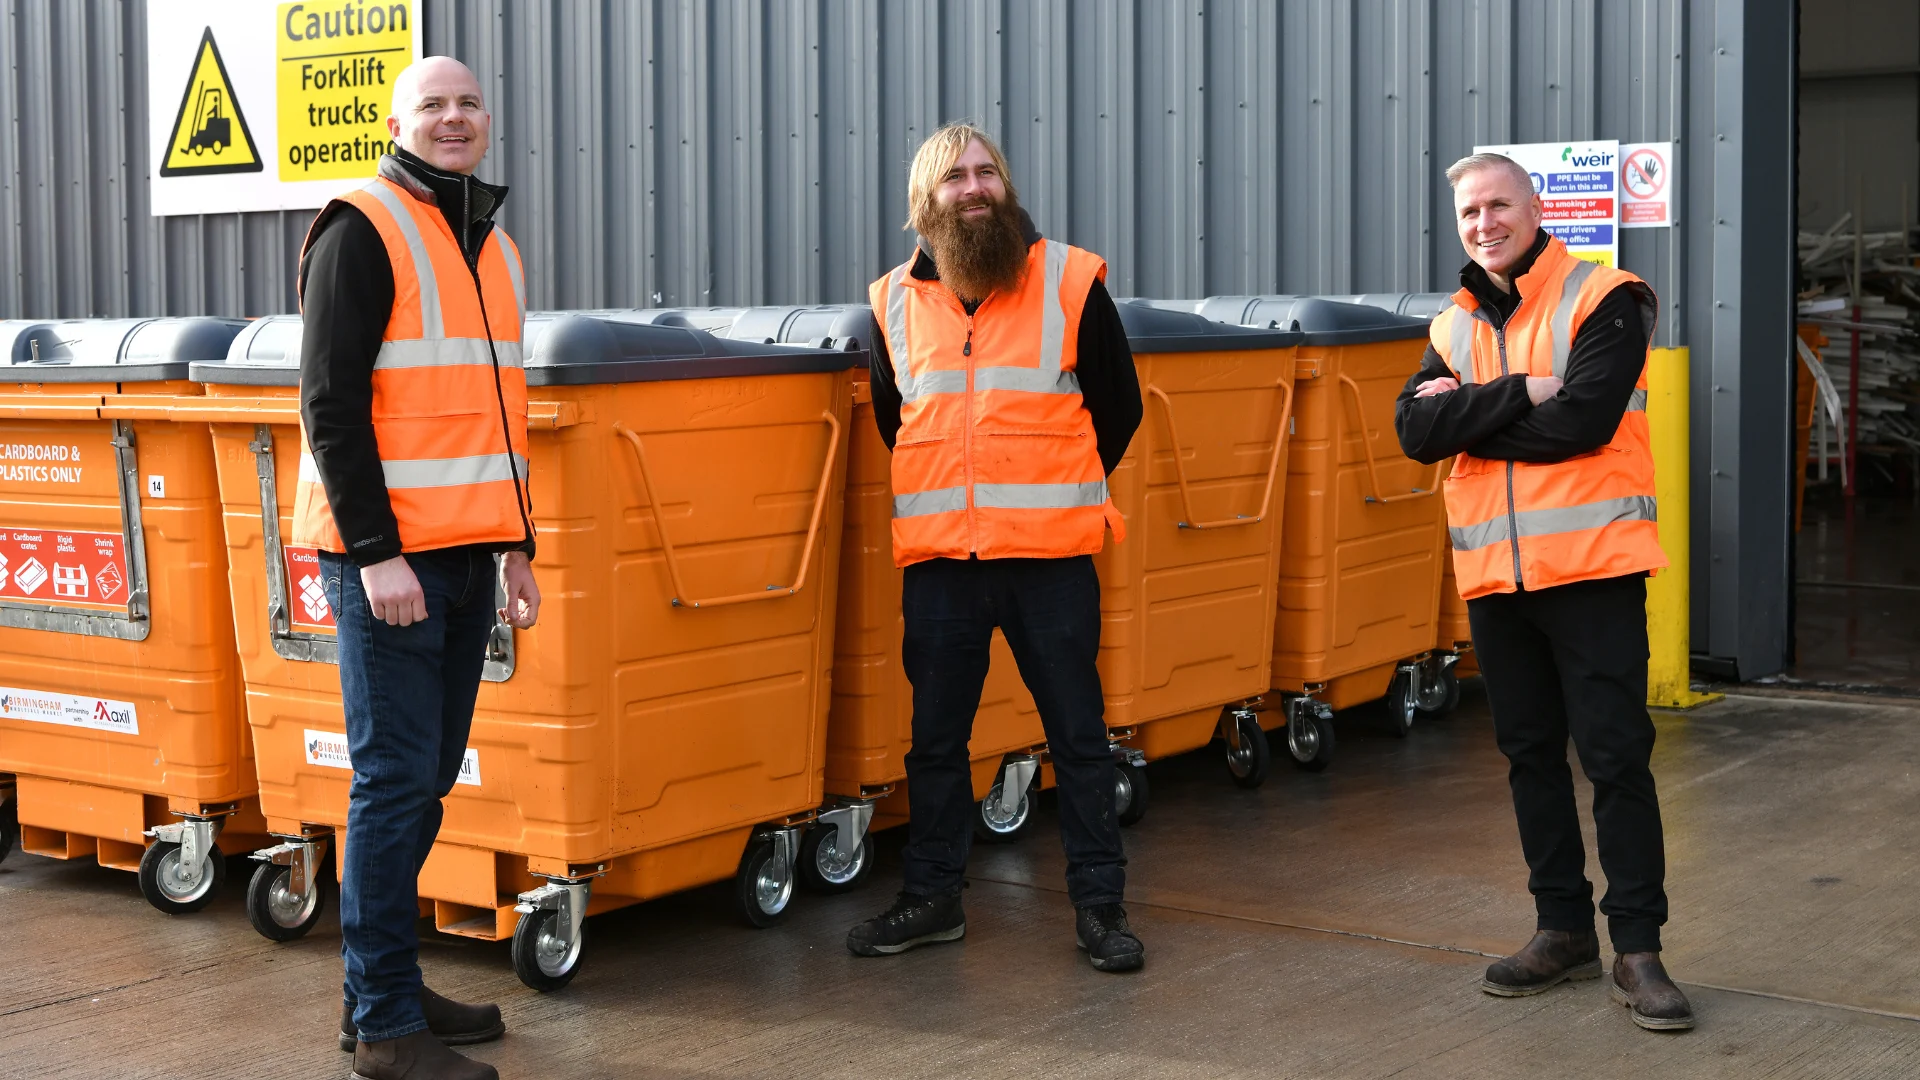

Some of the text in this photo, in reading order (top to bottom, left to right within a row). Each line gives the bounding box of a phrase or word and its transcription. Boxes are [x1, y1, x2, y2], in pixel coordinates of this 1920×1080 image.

[286, 0, 407, 41] Caution
[302, 57, 385, 91] Forklift
[308, 96, 378, 127] trucks
[1572, 152, 1614, 167] weir
[1573, 174, 1591, 182] Must
[1556, 200, 1587, 209] smoking
[1571, 209, 1607, 219] cigarettes
[1556, 226, 1570, 234] and
[1570, 235, 1590, 243] office
[0, 444, 81, 462] CARDBOARD &
[50, 466, 82, 483] ONLY
[152, 481, 162, 492] 14
[13, 533, 42, 542] Cardboard
[57, 535, 73, 546] Rigid
[20, 542, 38, 550] crates
[94, 538, 114, 548] Shrink
[57, 544, 76, 554] plastic
[97, 548, 113, 558] wrap
[8, 696, 62, 711] BIRMINGHAM
[110, 708, 130, 725] axil
